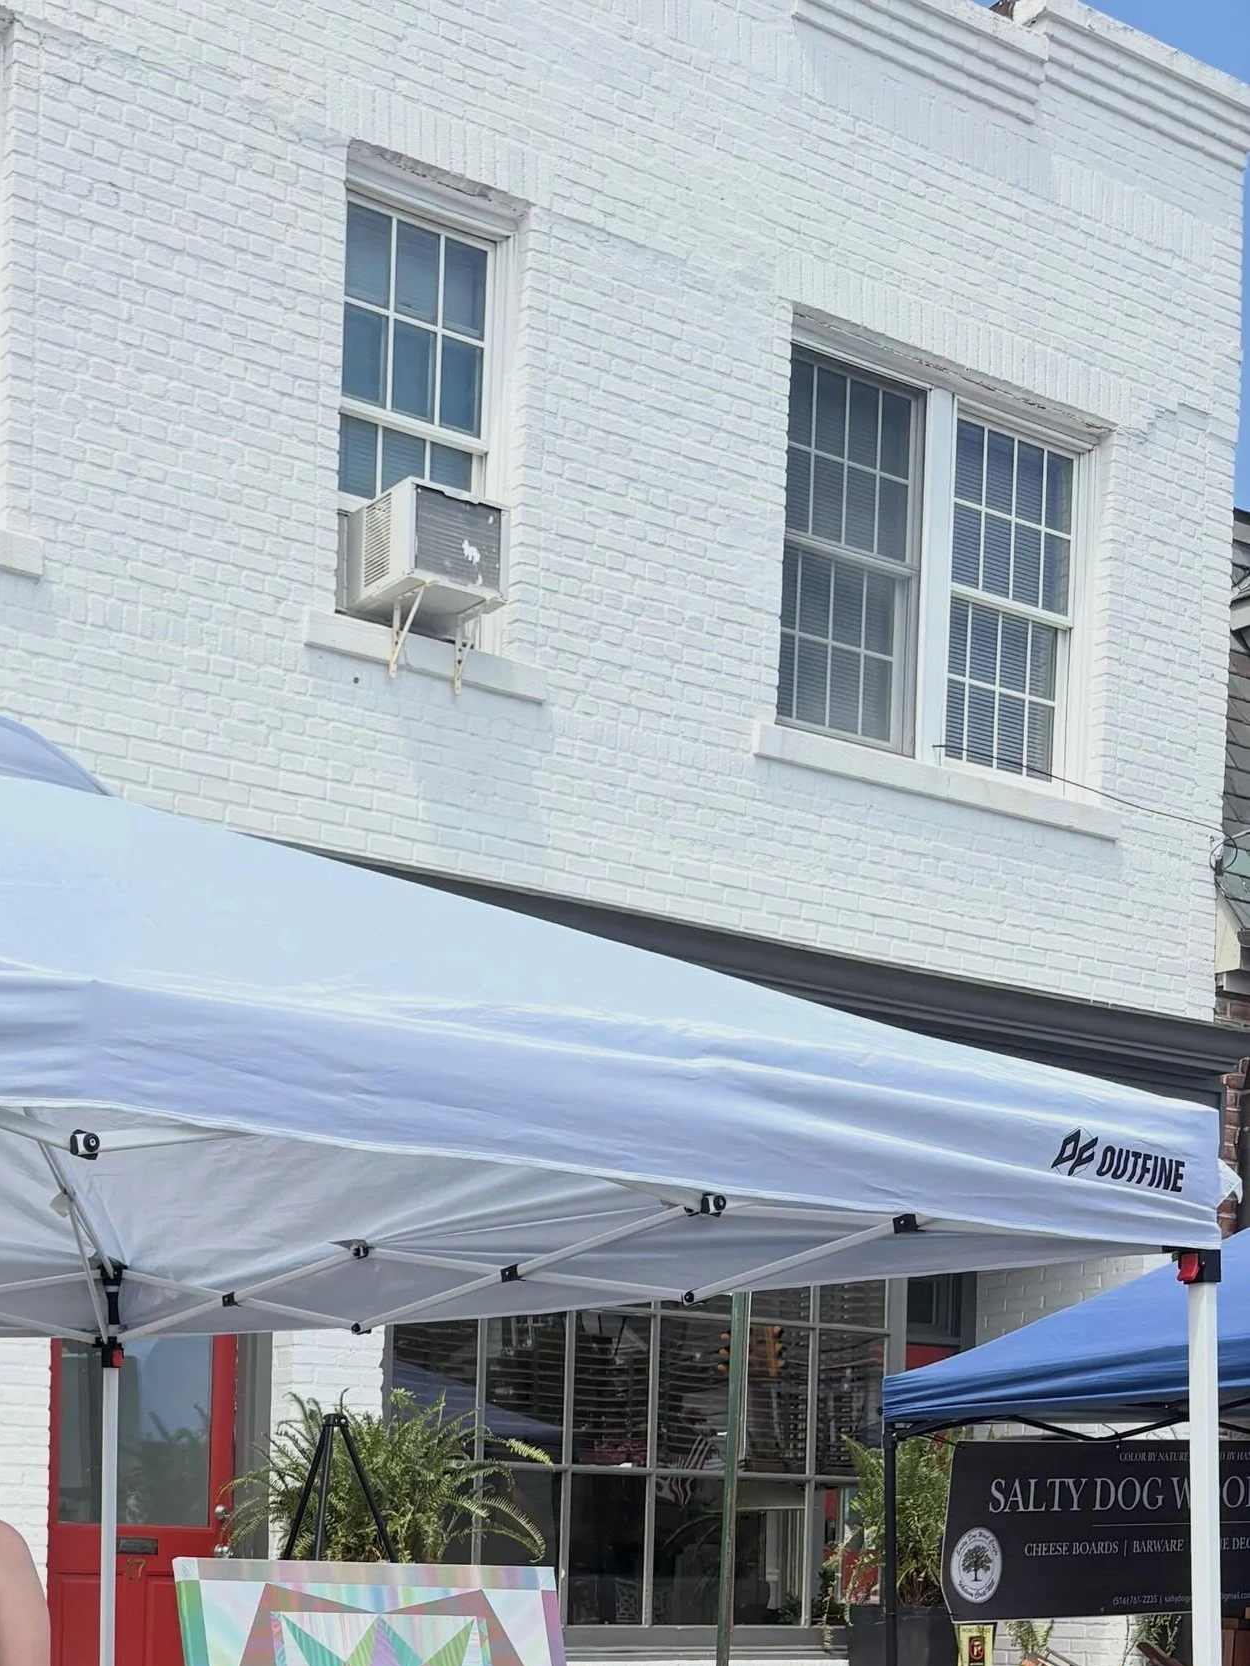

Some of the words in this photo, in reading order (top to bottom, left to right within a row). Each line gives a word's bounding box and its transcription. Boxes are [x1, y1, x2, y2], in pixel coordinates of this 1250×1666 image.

[1096, 1145, 1185, 1192] OUTFINE
[1119, 1451, 1146, 1462] COLOR
[988, 1477, 1088, 1513] SALTY
[1092, 1476, 1165, 1511] DOG
[1024, 1542, 1070, 1557] CHEESE
[1072, 1540, 1119, 1555] BOARDS
[1132, 1538, 1185, 1553] BARWARE
[126, 1559, 147, 1582] 17
